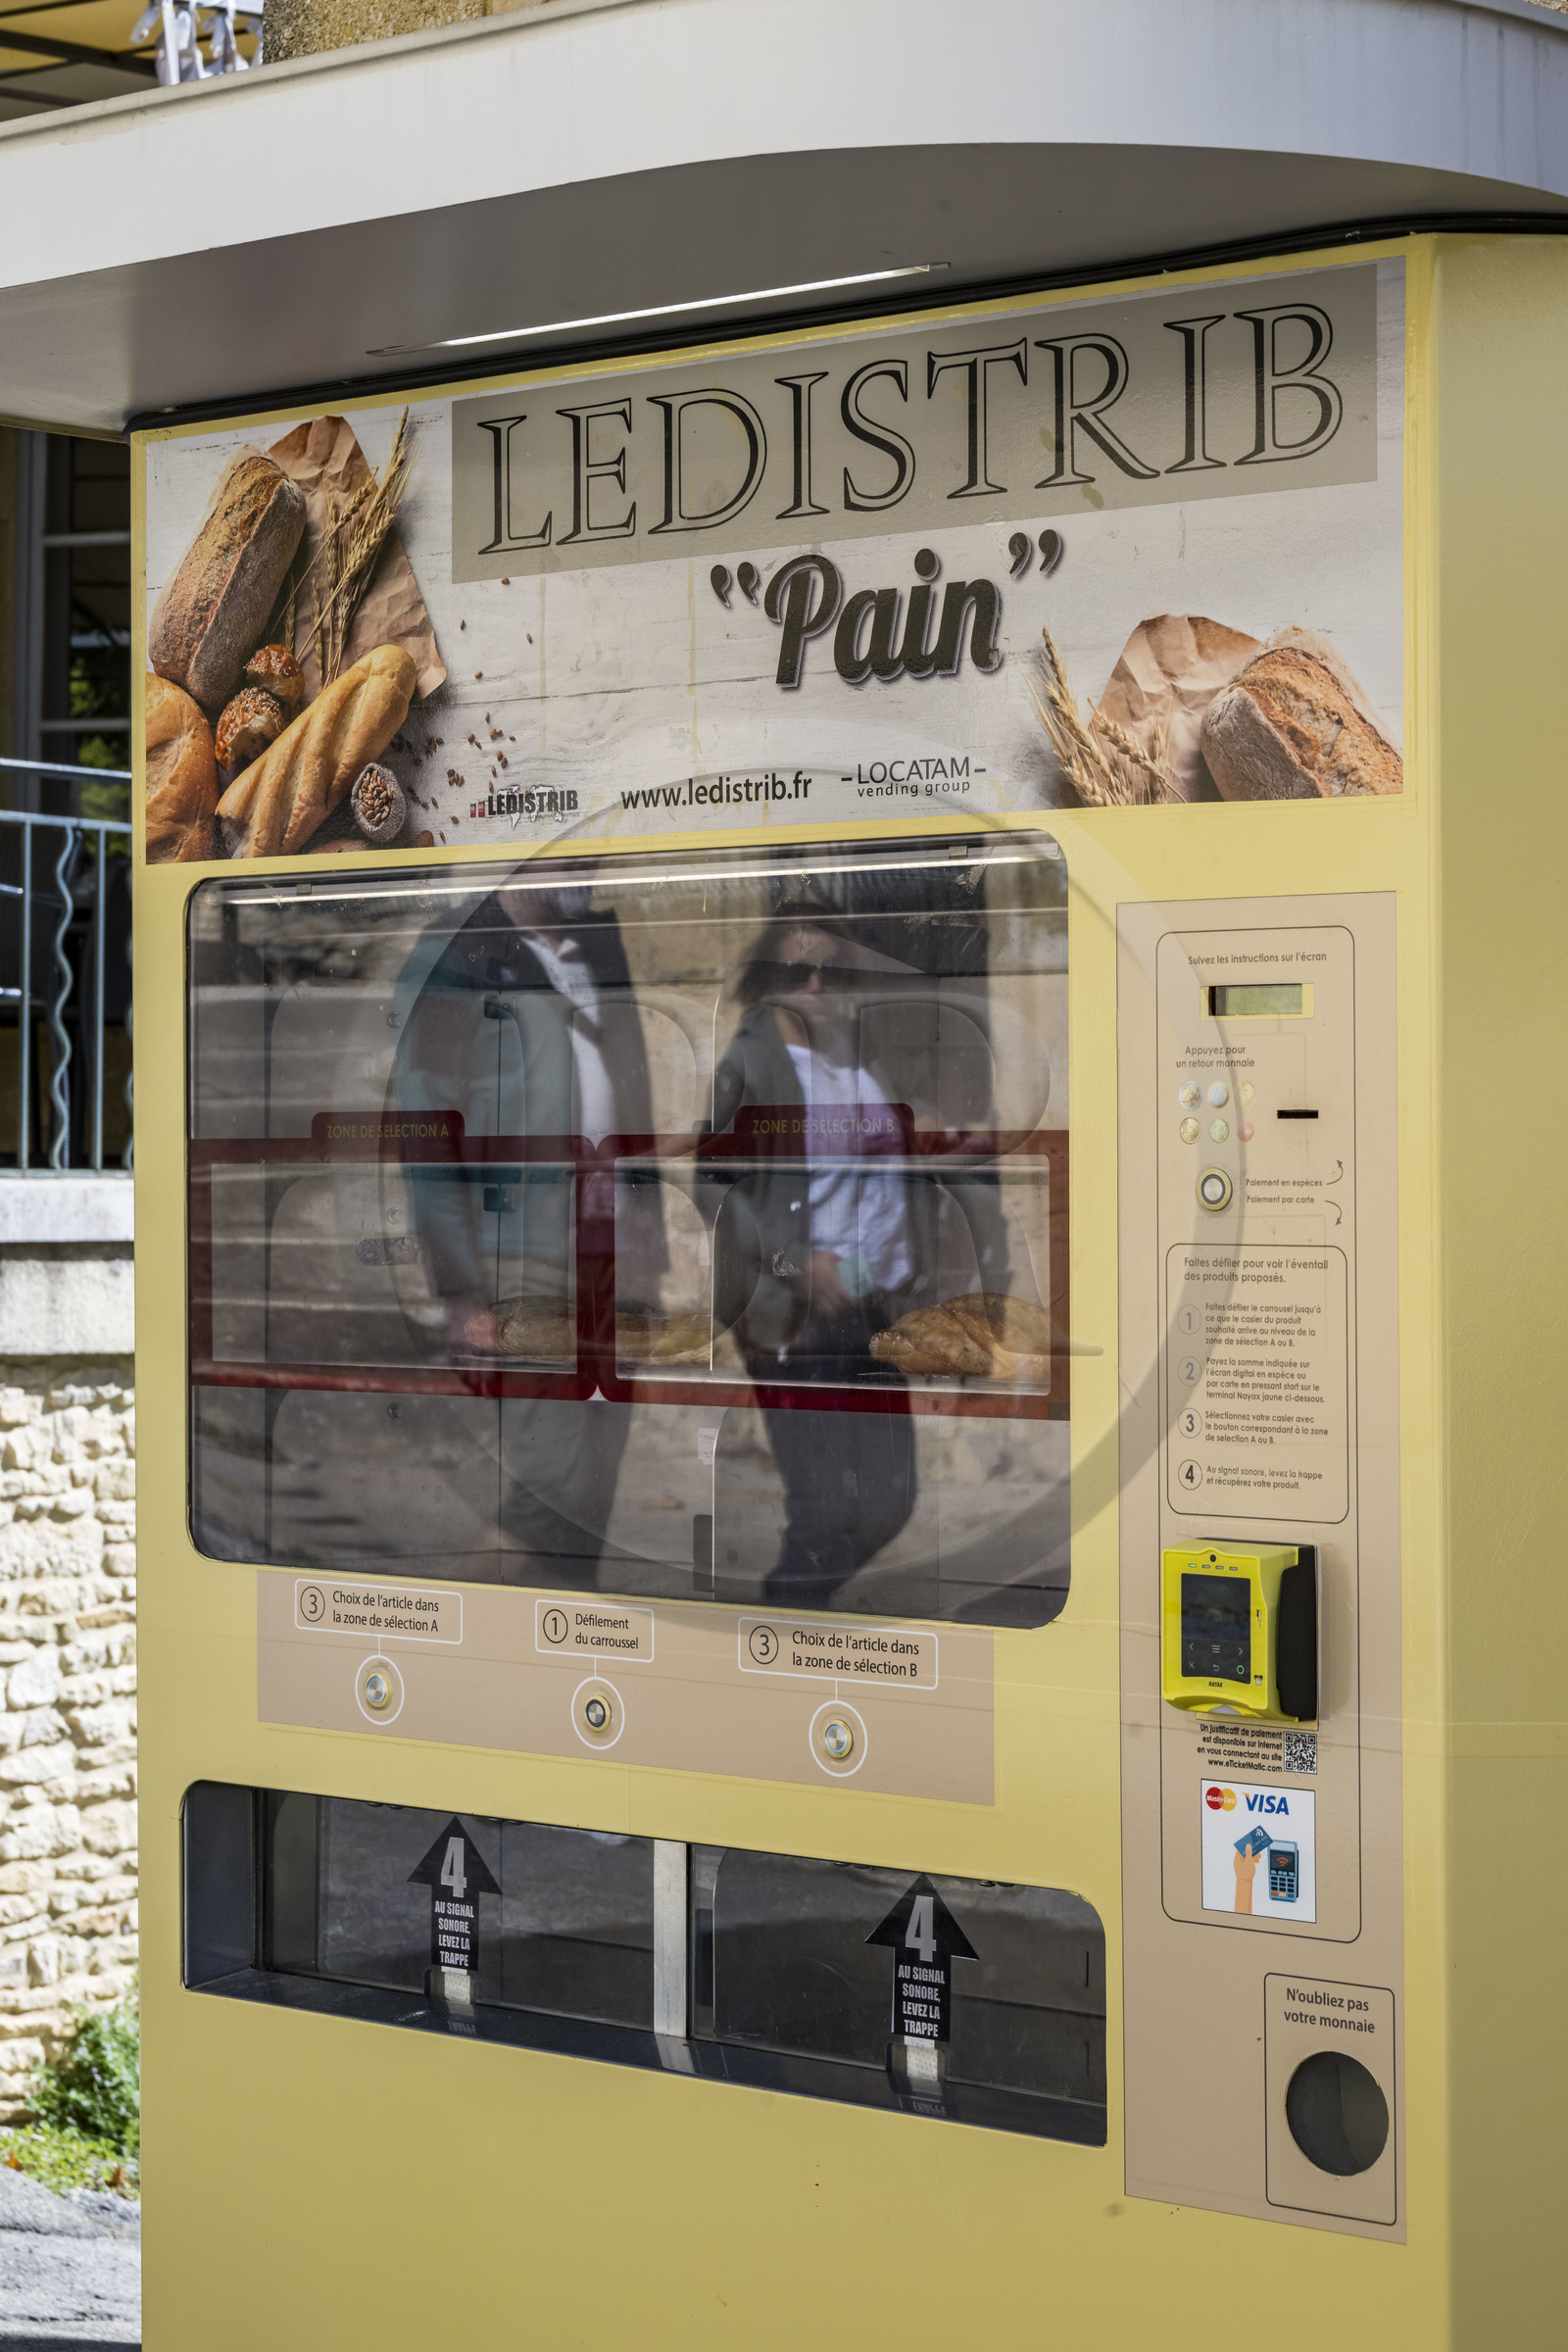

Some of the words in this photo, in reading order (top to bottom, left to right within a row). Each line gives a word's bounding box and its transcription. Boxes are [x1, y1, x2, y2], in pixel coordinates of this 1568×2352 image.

[477, 301, 1344, 557] LEDISTRIB
[620, 770, 811, 809] www.ledistrib.fr
[858, 781, 918, 798] vending
[925, 780, 970, 796] group
[488, 790, 578, 815] LEDISTRIB
[1188, 955, 1215, 965] Suivez
[1216, 954, 1229, 963] les
[1231, 953, 1279, 963] instructions
[1281, 954, 1294, 962] sur
[1296, 951, 1327, 962] l'écran
[1185, 1046, 1223, 1057] Appuyez
[1225, 1046, 1246, 1056] pour
[1189, 1059, 1214, 1068] retour
[1216, 1058, 1254, 1067] monnaie
[326, 1125, 357, 1138] ZONE
[361, 1125, 373, 1138] DE
[377, 1124, 437, 1138] SELECTION
[440, 1124, 449, 1137] A
[753, 1120, 788, 1134] ZONE
[792, 1119, 808, 1133] DE
[812, 1118, 882, 1133] SELECTION
[887, 1118, 894, 1132] B
[1246, 1178, 1279, 1187] Paiement
[1293, 1178, 1322, 1188] espèces
[1184, 1257, 1209, 1267] Faites
[1212, 1258, 1240, 1268] défiler
[1244, 1260, 1264, 1269] pour
[1266, 1259, 1283, 1268] voir
[1286, 1258, 1328, 1269] l'éventail
[1184, 1272, 1200, 1281] des
[1203, 1272, 1239, 1283] produits
[1242, 1273, 1286, 1284] proposés.
[1295, 1304, 1321, 1314] jusqu'à
[1187, 1312, 1192, 1330] 1
[1276, 1316, 1301, 1325] produit
[1238, 1326, 1257, 1335] arrive
[1236, 1337, 1268, 1346] sélection
[1206, 1357, 1227, 1366] Payez
[1185, 1362, 1195, 1380] 2
[1206, 1368, 1231, 1377] l'écran
[1233, 1369, 1254, 1378] digital
[1268, 1371, 1295, 1380] espèce
[1238, 1392, 1260, 1401] Nayax
[1262, 1393, 1282, 1401] jaune
[1285, 1394, 1325, 1403] ci-dessous.
[1186, 1414, 1195, 1432] 3
[1205, 1411, 1250, 1420] Sélectionnez
[1241, 1424, 1294, 1434] correspondant
[1185, 1465, 1195, 1483] 4
[1218, 1466, 1239, 1476] signal
[1268, 1469, 1288, 1478] levez
[1298, 1471, 1323, 1480] trappe
[1215, 1478, 1250, 1487] récupérez
[309, 1594, 318, 1614] 3
[333, 1591, 361, 1605] Choix
[363, 1593, 375, 1606] de
[378, 1594, 413, 1609] l'article
[416, 1598, 439, 1612] dans
[333, 1610, 341, 1622] la
[343, 1614, 367, 1625] zone
[369, 1614, 381, 1627] de
[384, 1616, 428, 1631] sélection
[431, 1620, 438, 1632] A
[552, 1617, 558, 1636] 1
[575, 1613, 629, 1630] Défilement
[575, 1632, 588, 1644] du
[590, 1636, 639, 1649] carroussel
[760, 1634, 770, 1656] 3
[793, 1631, 825, 1646] Choix
[828, 1634, 843, 1648] de
[846, 1636, 888, 1652] l'article
[891, 1640, 919, 1655] dans
[793, 1652, 802, 1666] la
[805, 1656, 833, 1669] zone
[836, 1656, 851, 1670] de
[854, 1658, 906, 1676] sélection
[910, 1663, 917, 1677] B
[1213, 1736, 1246, 1746] disponible
[1251, 1730, 1282, 1739] paiement
[1223, 1749, 1259, 1759] connectant
[1206, 1794, 1236, 1803] MasterCard
[1244, 1793, 1289, 1815] VISA
[441, 1837, 467, 1898] 4
[434, 1900, 446, 1914] AU
[447, 1902, 474, 1918] SIGNAL
[438, 1918, 470, 1935] SONORE,
[906, 1894, 937, 1962] 4
[439, 1935, 460, 1949] LEVEZ
[461, 1937, 470, 1950] LA
[440, 1950, 468, 1967] TRAPPE
[898, 1965, 910, 1979] AU
[912, 1966, 945, 1984] SIGNAL
[903, 1984, 941, 2002] SONORE,
[1287, 1987, 1344, 2008] N'oubliez
[1348, 1998, 1369, 2012] pas
[903, 2001, 928, 2017] LEVEZ
[929, 2005, 940, 2019] LA
[904, 2019, 939, 2037] TRAPPE
[1284, 2011, 1316, 2025] votre
[1320, 2014, 1375, 2034] monnaie
